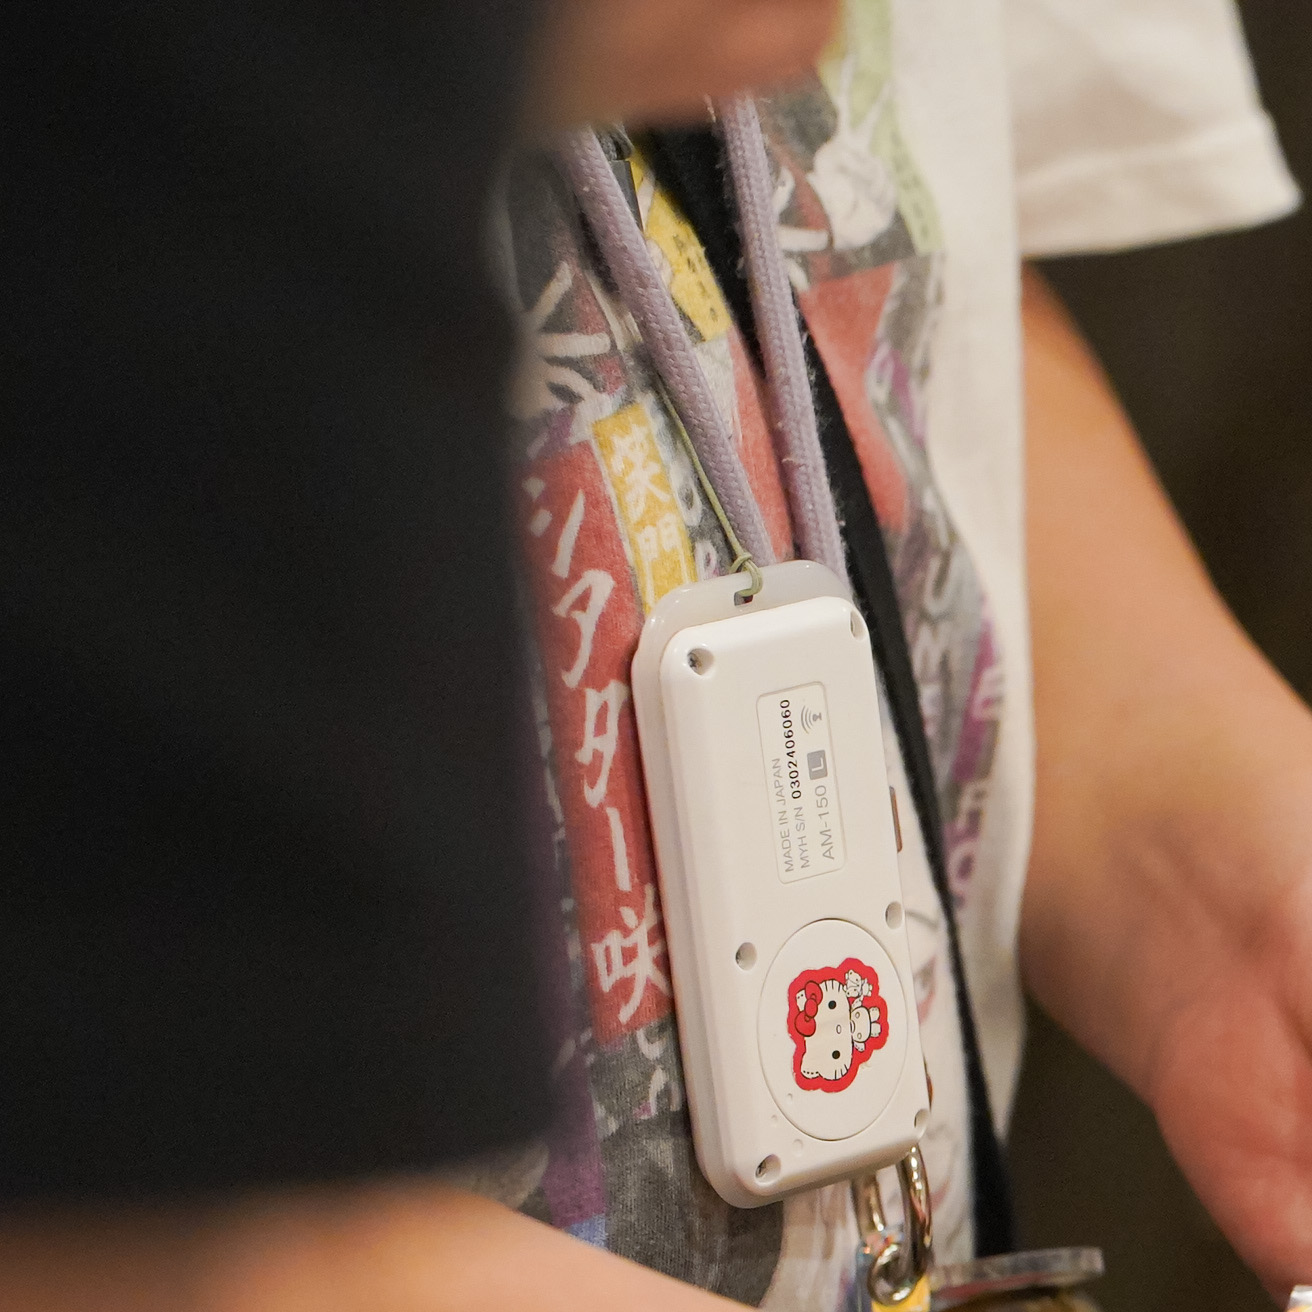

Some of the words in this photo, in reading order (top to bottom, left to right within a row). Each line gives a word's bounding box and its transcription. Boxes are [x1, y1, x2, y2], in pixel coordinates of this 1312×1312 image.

[779, 699, 802, 800] 0302406060
[771, 758, 786, 805] JAPAN
[778, 810, 788, 826] IN
[793, 806, 806, 832] S/N
[814, 784, 835, 860] AM-150
[780, 828, 794, 873] MADE
[797, 835, 810, 868] MYH
